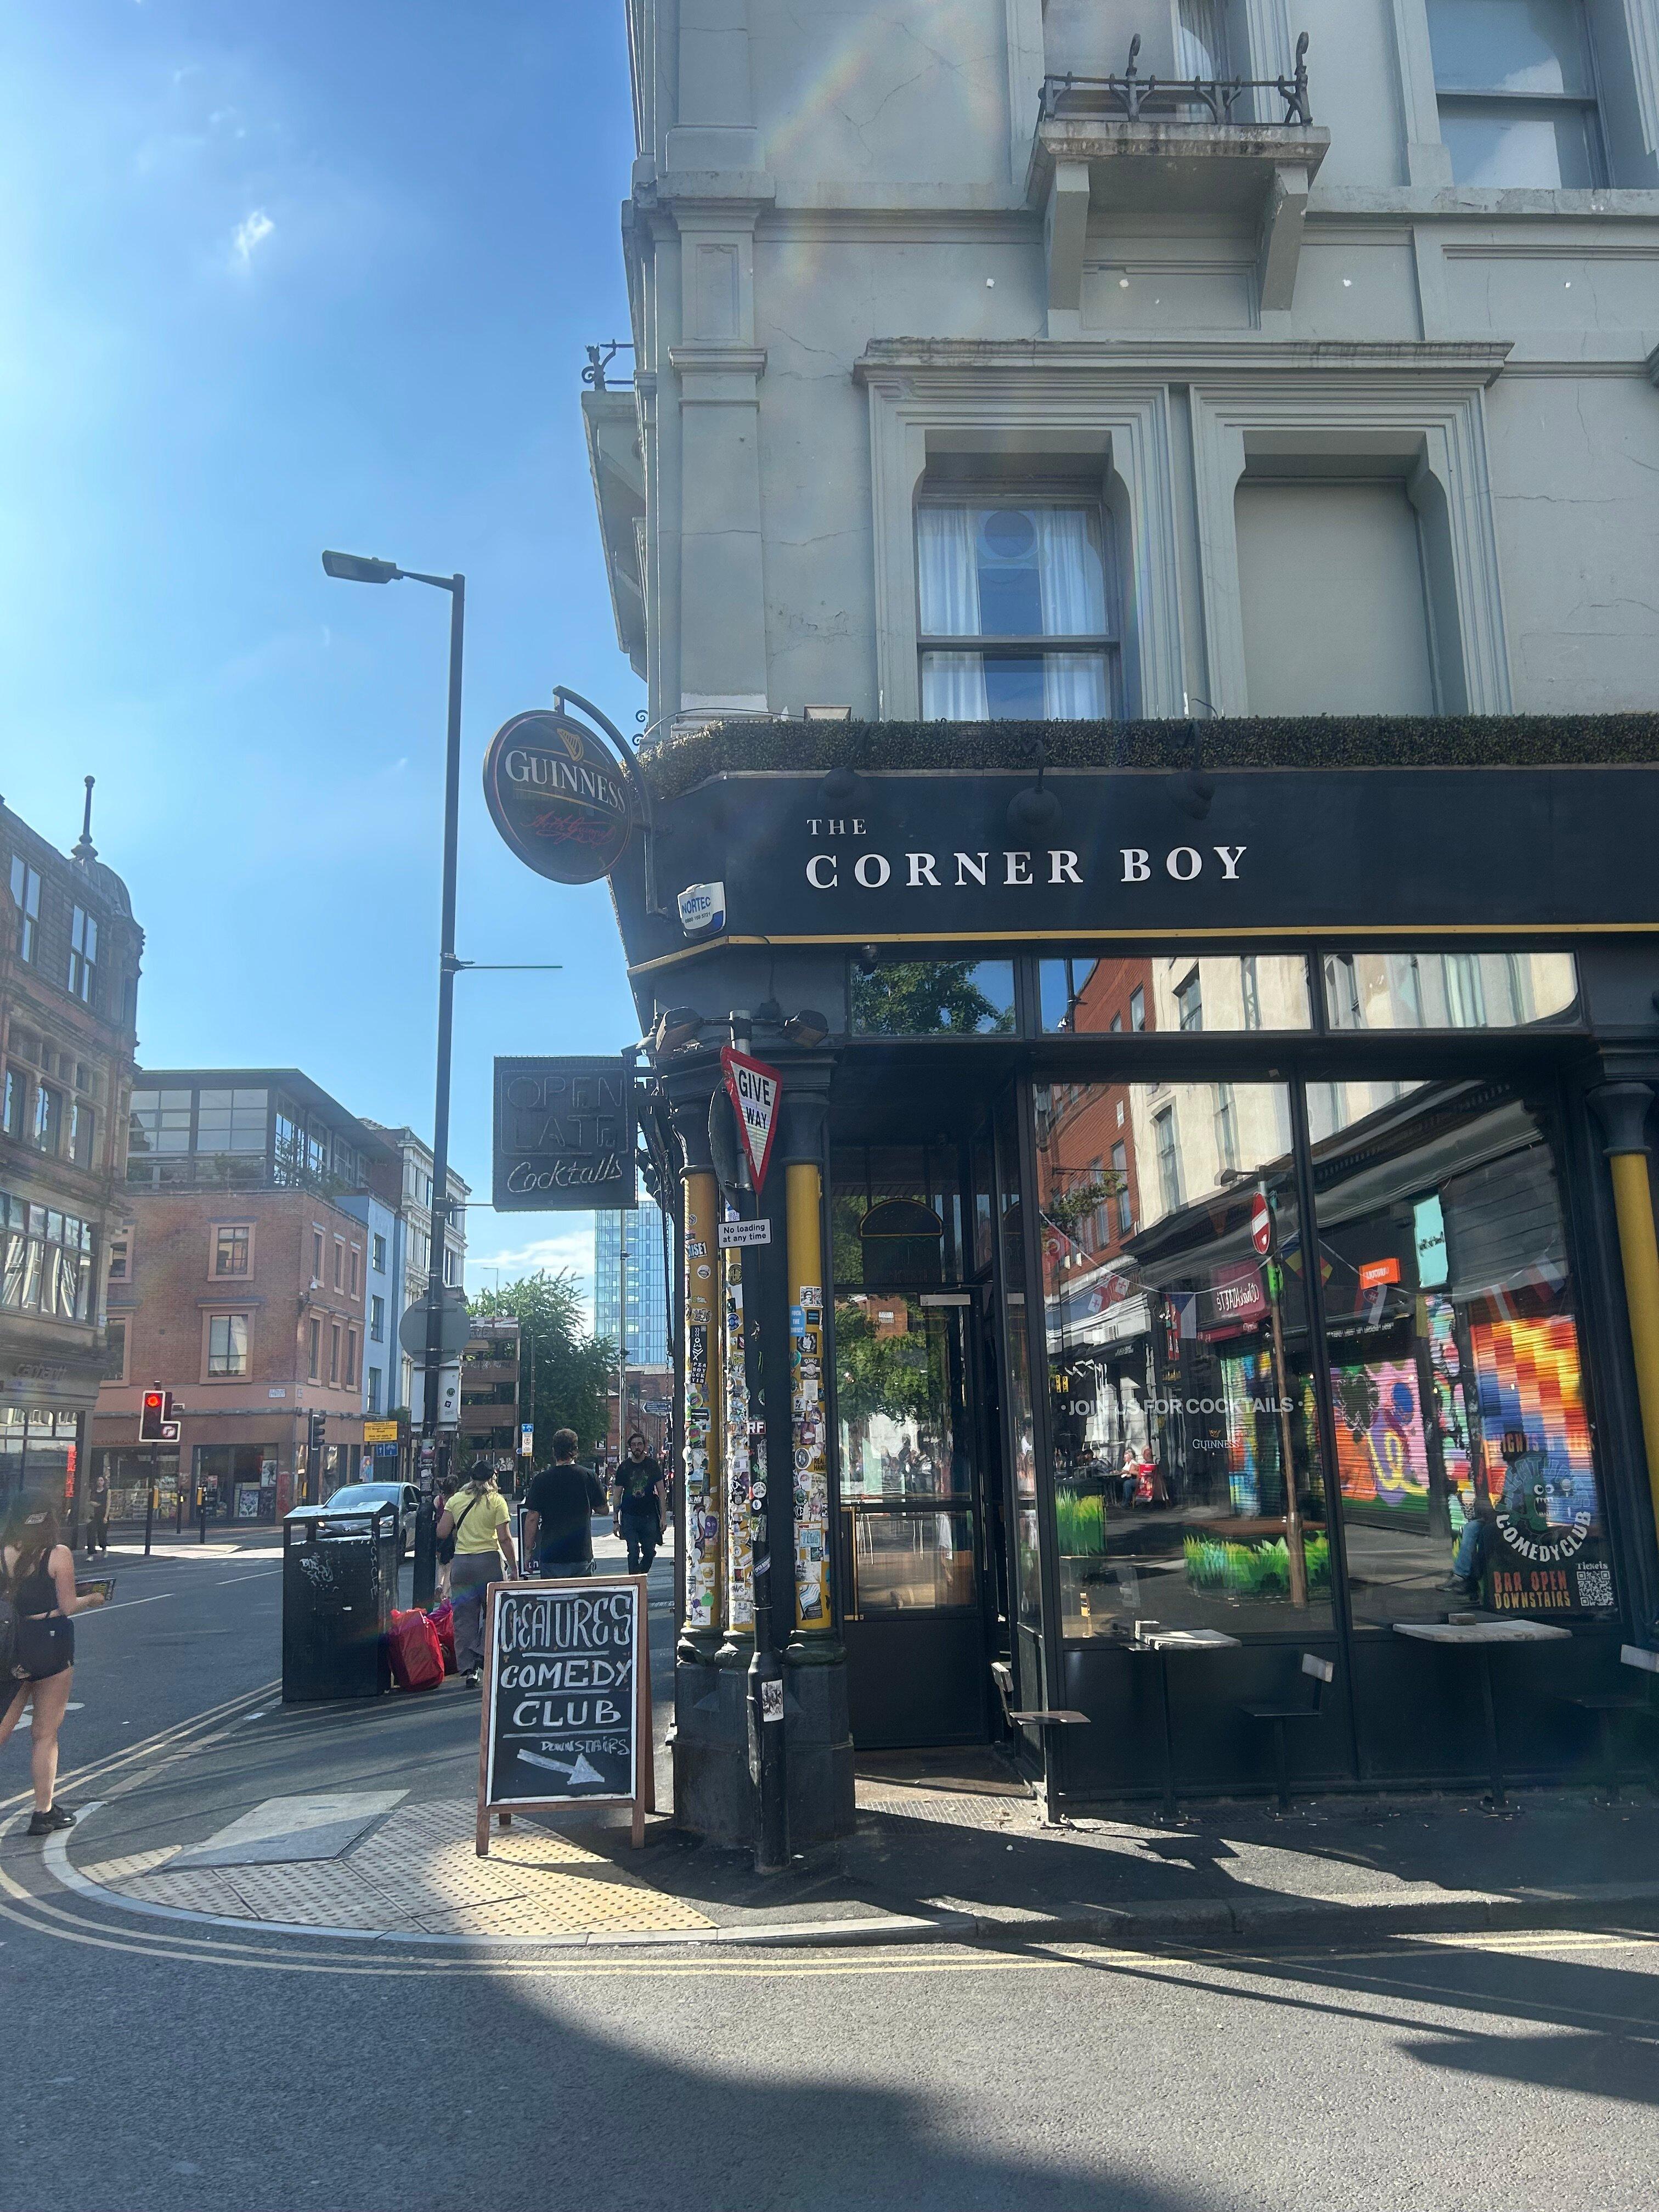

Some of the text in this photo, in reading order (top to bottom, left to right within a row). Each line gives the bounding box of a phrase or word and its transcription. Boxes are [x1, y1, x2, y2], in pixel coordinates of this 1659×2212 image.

[505, 750, 626, 813] GUINNESS
[806, 818, 867, 836] THE
[805, 845, 1248, 889] CORNER BOY
[681, 896, 712, 914] NORTEC
[507, 1076, 624, 1109] OPEN
[738, 1069, 771, 1107] GIVE
[746, 1109, 768, 1130] WAY
[513, 1114, 616, 1149] LATE
[737, 1224, 765, 1232] loading
[1069, 1397, 1294, 1416] JOIN US FOR COCKTAILS
[748, 1421, 764, 1434] RF
[1192, 1438, 1240, 1450] GUINNESS
[1493, 1570, 1568, 1593] BAR OPEN
[1493, 1591, 1571, 1610] DOWNSTAIRS
[500, 1658, 632, 1690] COMEDY
[512, 1699, 622, 1727] CLUB
